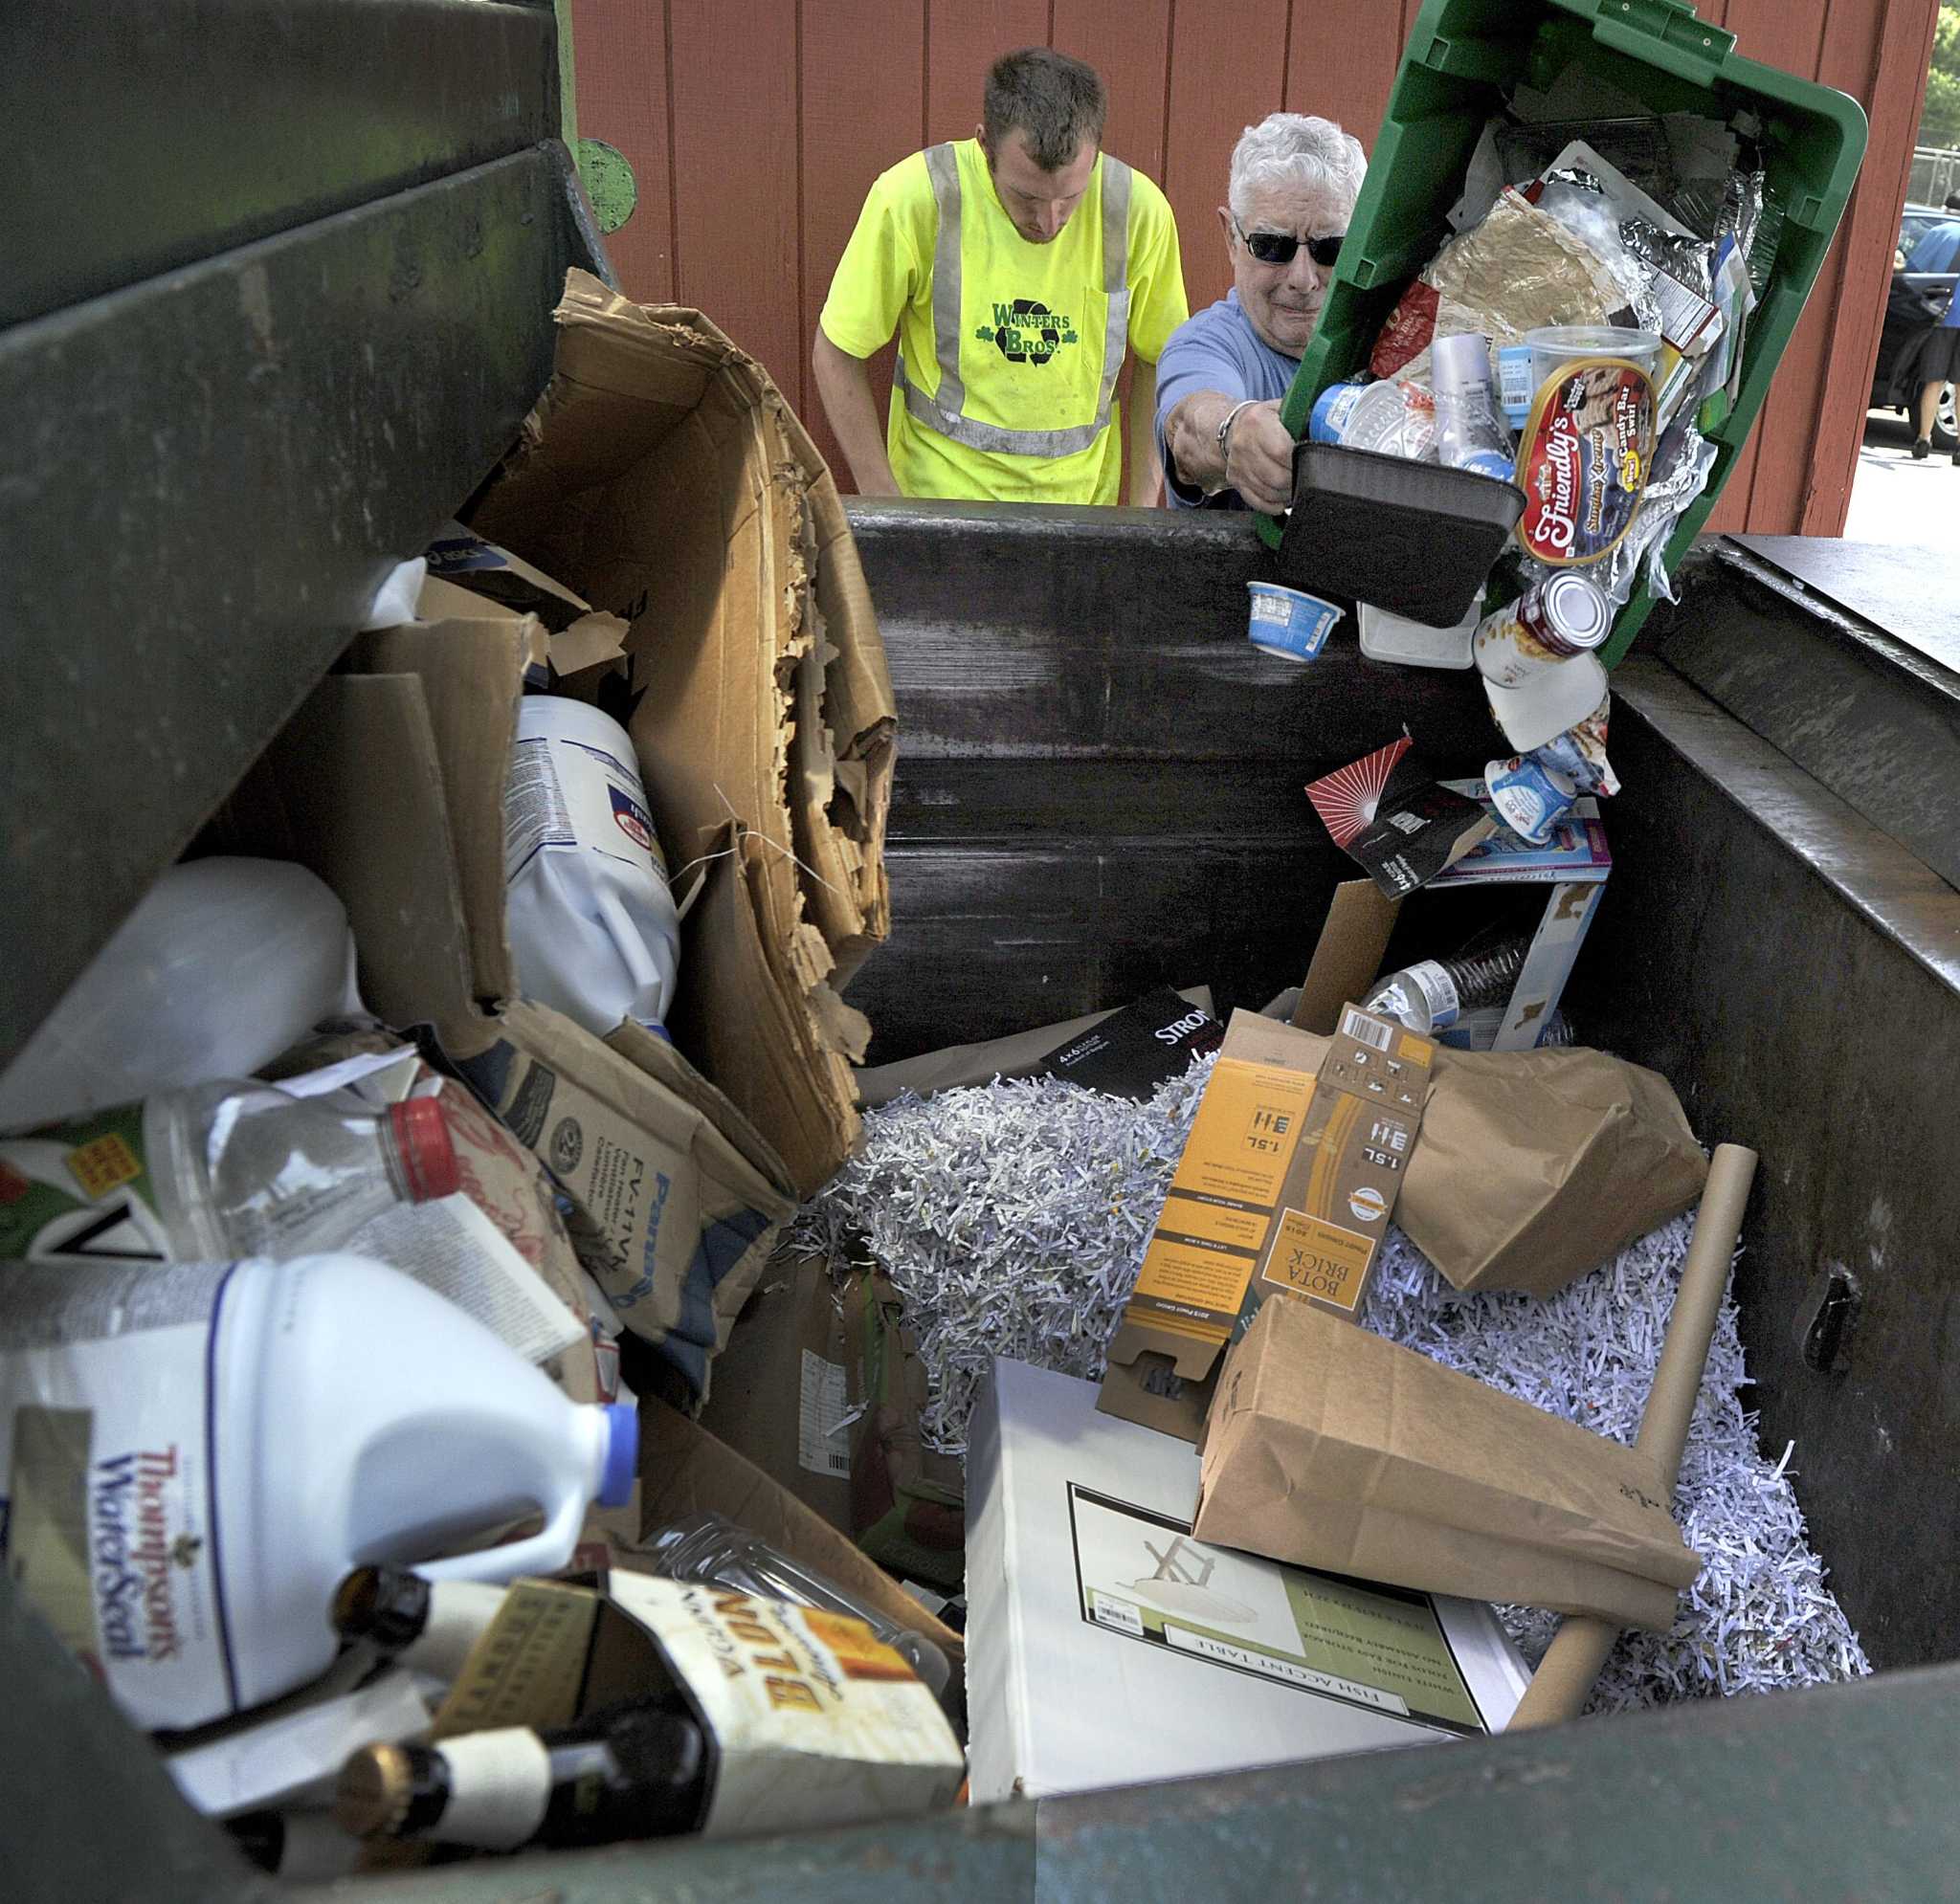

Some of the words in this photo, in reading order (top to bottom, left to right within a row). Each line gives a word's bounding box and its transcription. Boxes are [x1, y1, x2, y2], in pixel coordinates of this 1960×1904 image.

[992, 303, 1070, 329] WINTERS
[1006, 330, 1061, 355] BROS.
[1616, 386, 1630, 411] Bar
[1626, 403, 1637, 438] Swirl
[1616, 412, 1628, 457] Candy
[1534, 416, 1579, 548] Friendly's
[1245, 1136, 1280, 1153] 1.5L
[1361, 1146, 1399, 1169] 1.5L
[1287, 1248, 1349, 1282] BRICK
[1283, 1264, 1340, 1296] BOTA
[1195, 1640, 1251, 1662] TABLE
[1258, 1659, 1332, 1686] ACCENT
[1338, 1682, 1379, 1702] FISH
